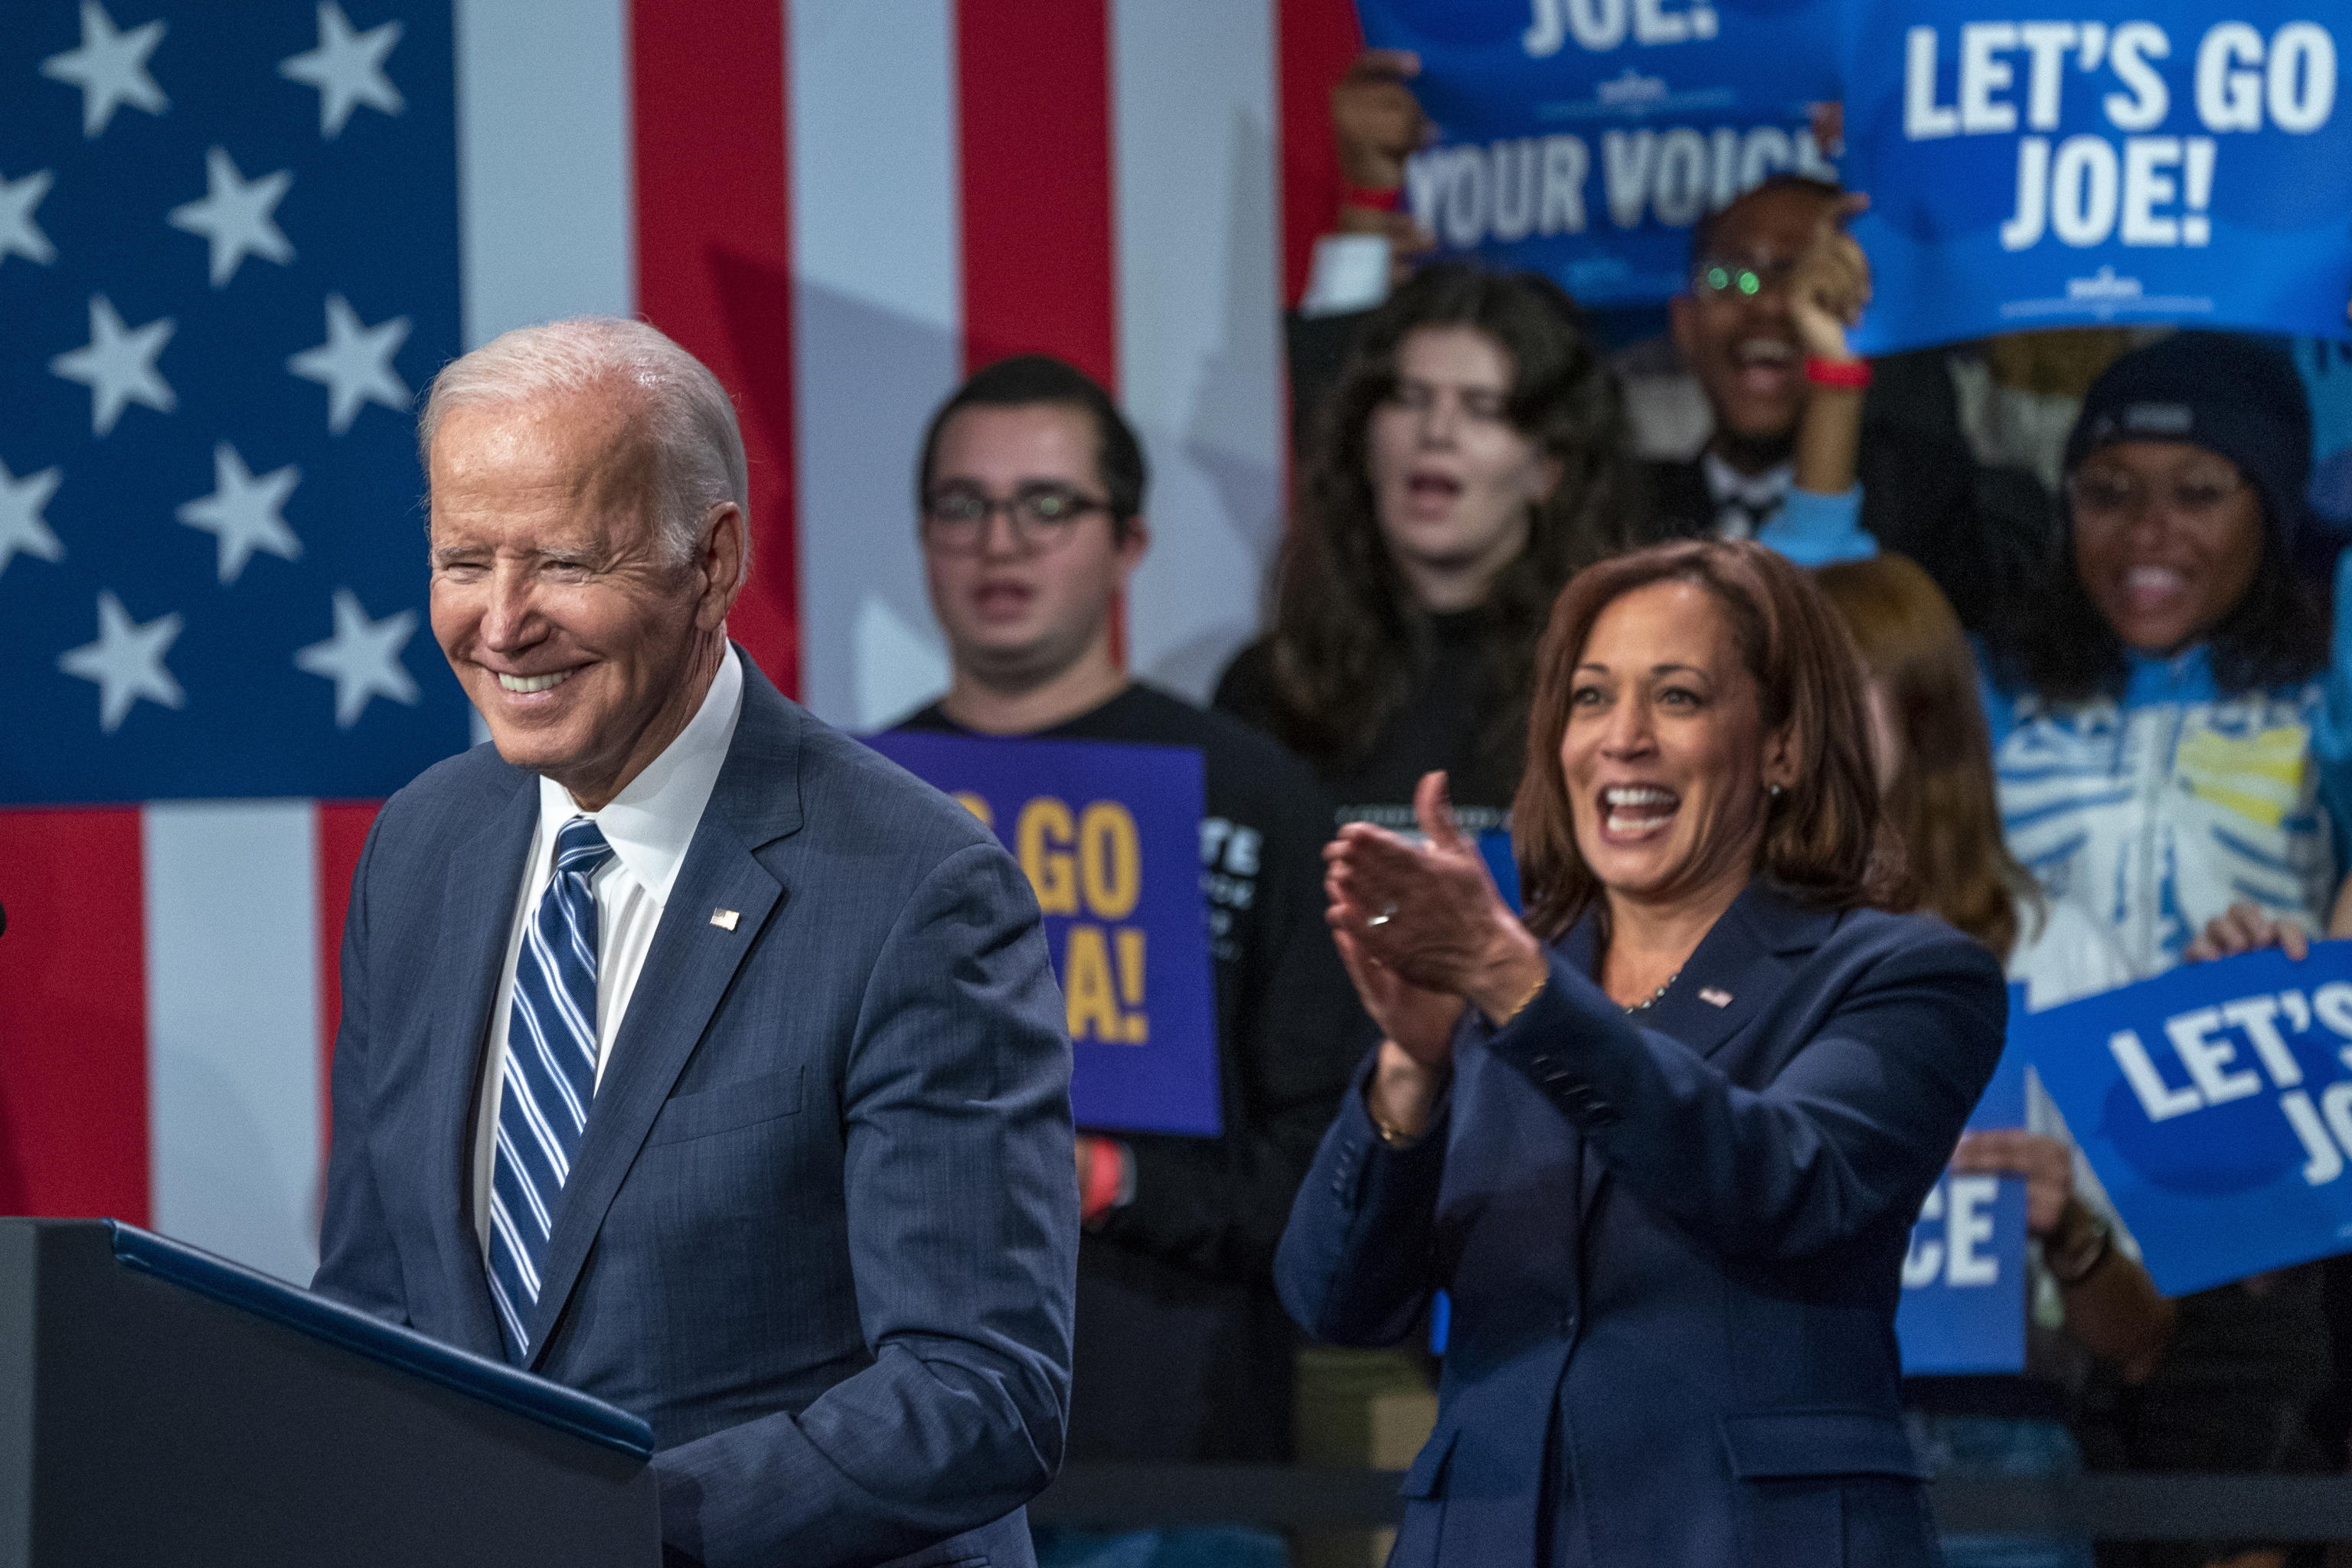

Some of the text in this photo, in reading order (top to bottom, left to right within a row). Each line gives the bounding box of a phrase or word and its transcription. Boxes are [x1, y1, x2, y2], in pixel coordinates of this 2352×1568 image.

[1903, 19, 2338, 141] LET'S GO
[1404, 134, 1589, 247] YOUR
[2000, 133, 2217, 251] JOE!
[1014, 795, 1142, 920] GO
